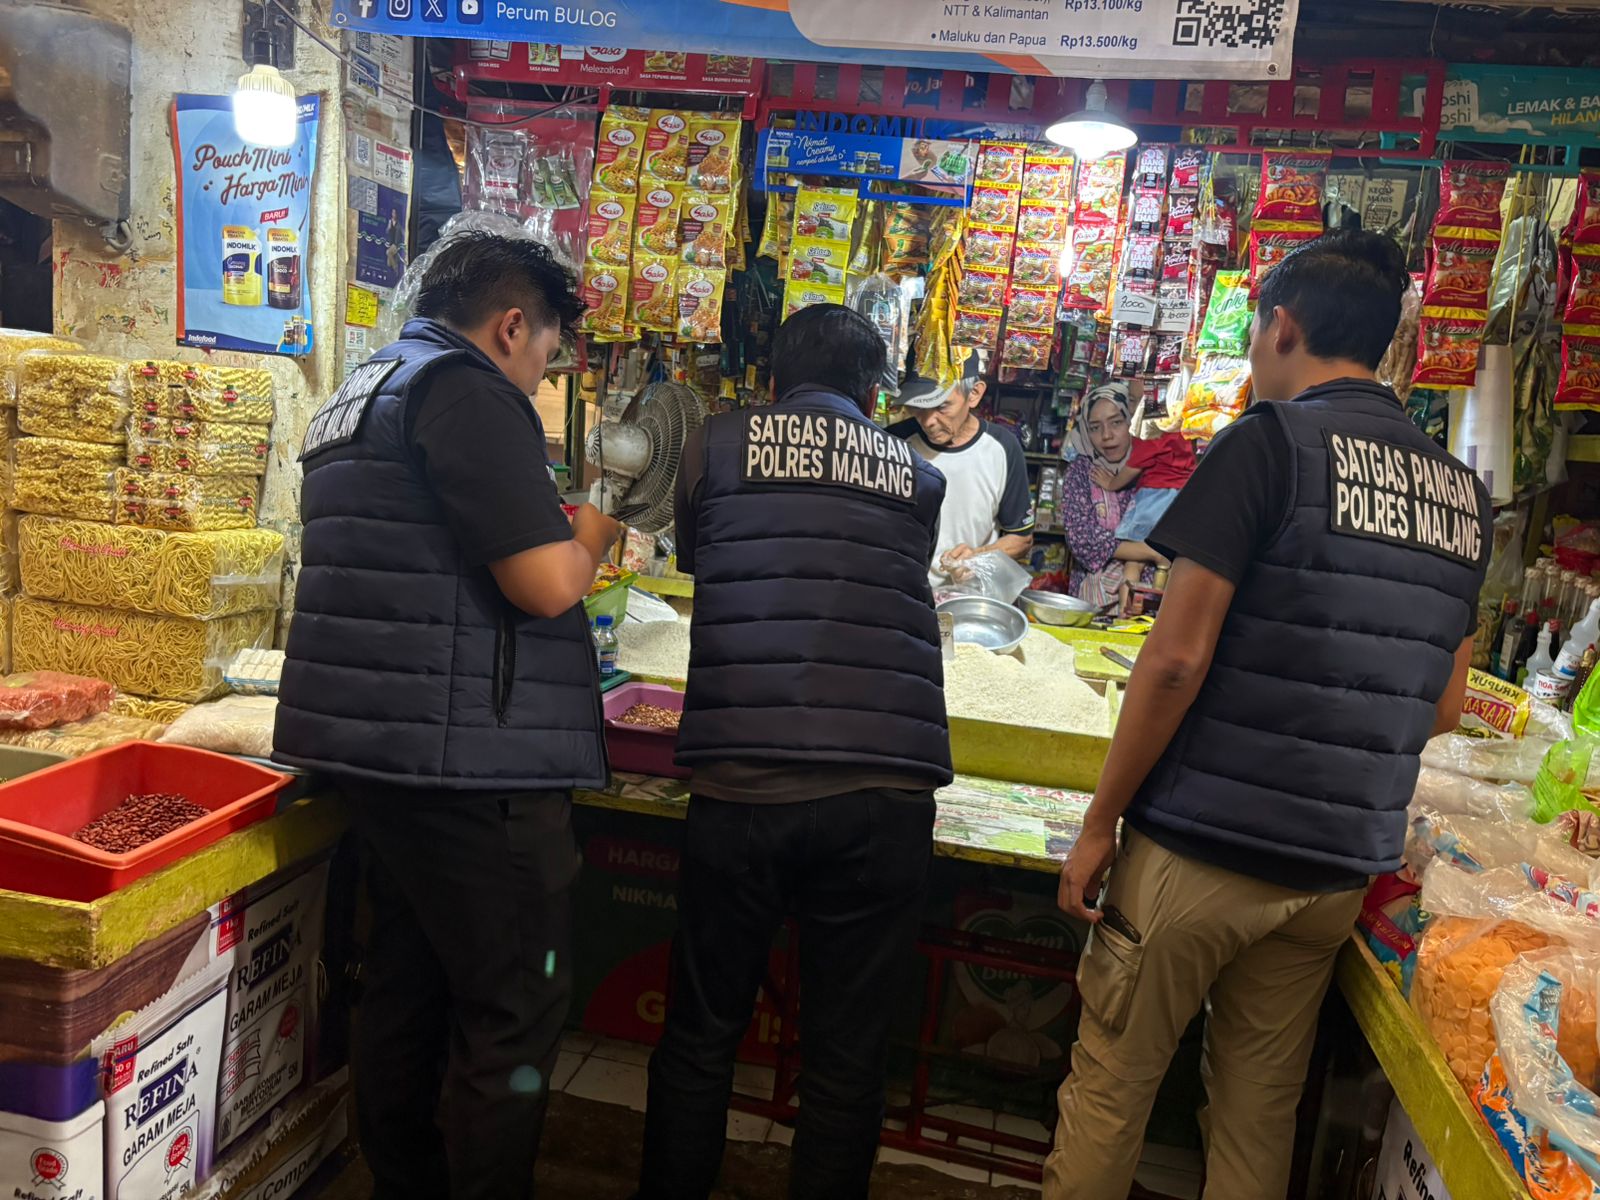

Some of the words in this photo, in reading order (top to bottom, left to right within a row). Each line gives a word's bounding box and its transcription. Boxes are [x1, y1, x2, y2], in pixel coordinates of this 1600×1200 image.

[496, 4, 548, 23] Perum
[555, 8, 617, 28] BULOG
[943, 5, 970, 17] NTT
[972, 6, 982, 17] &
[984, 6, 1049, 20] Kalimantan
[939, 30, 982, 43] Maluku
[984, 31, 1006, 44] dan
[1008, 33, 1047, 47] Papua
[1060, 35, 1138, 50] Rp13.500/kg
[580, 63, 630, 75] Melezatkan!
[1507, 100, 1561, 115] LEMAK
[1564, 97, 1575, 109] &
[796, 135, 828, 151] Nikmat
[193, 143, 253, 171] Pouch
[252, 146, 291, 172] Mini
[806, 144, 836, 158] Creamy
[1141, 158, 1164, 166] UANG
[1140, 166, 1164, 174] EMAS
[220, 172, 279, 205] Harga
[278, 172, 309, 198] Mini
[1368, 187, 1393, 195] KECAP
[1366, 195, 1393, 203] MANIS
[1134, 214, 1159, 222] EMAS
[1135, 207, 1159, 215] UANG
[226, 242, 256, 250] INDOMILK
[1257, 233, 1308, 247] Mazzo
[1438, 240, 1497, 255] Mazzoni
[271, 245, 298, 253] INDOMILK
[1130, 260, 1154, 269] EMAS
[1131, 253, 1154, 261] UANG
[187, 333, 216, 345] Indofood
[749, 414, 828, 448] SATGAS
[835, 418, 913, 466] PANGAN
[746, 444, 824, 479] POLRES
[831, 451, 913, 498] MALANG
[1332, 434, 1409, 494] SATGAS
[1410, 452, 1479, 517] PANGAN
[1336, 481, 1409, 540] POLRES
[1414, 500, 1481, 561] MALANG
[248, 909, 282, 943] Refined
[236, 927, 302, 993] REFINA
[229, 988, 271, 1033] GARAM
[272, 963, 303, 998] MEJA
[114, 1040, 134, 1056] ARU
[137, 1046, 174, 1083] Refined
[176, 1034, 194, 1056] Salt
[124, 1060, 199, 1131] REFINA
[123, 1124, 165, 1167] GARAM
[166, 1094, 197, 1129] MEJA
[171, 1137, 186, 1152] Food
